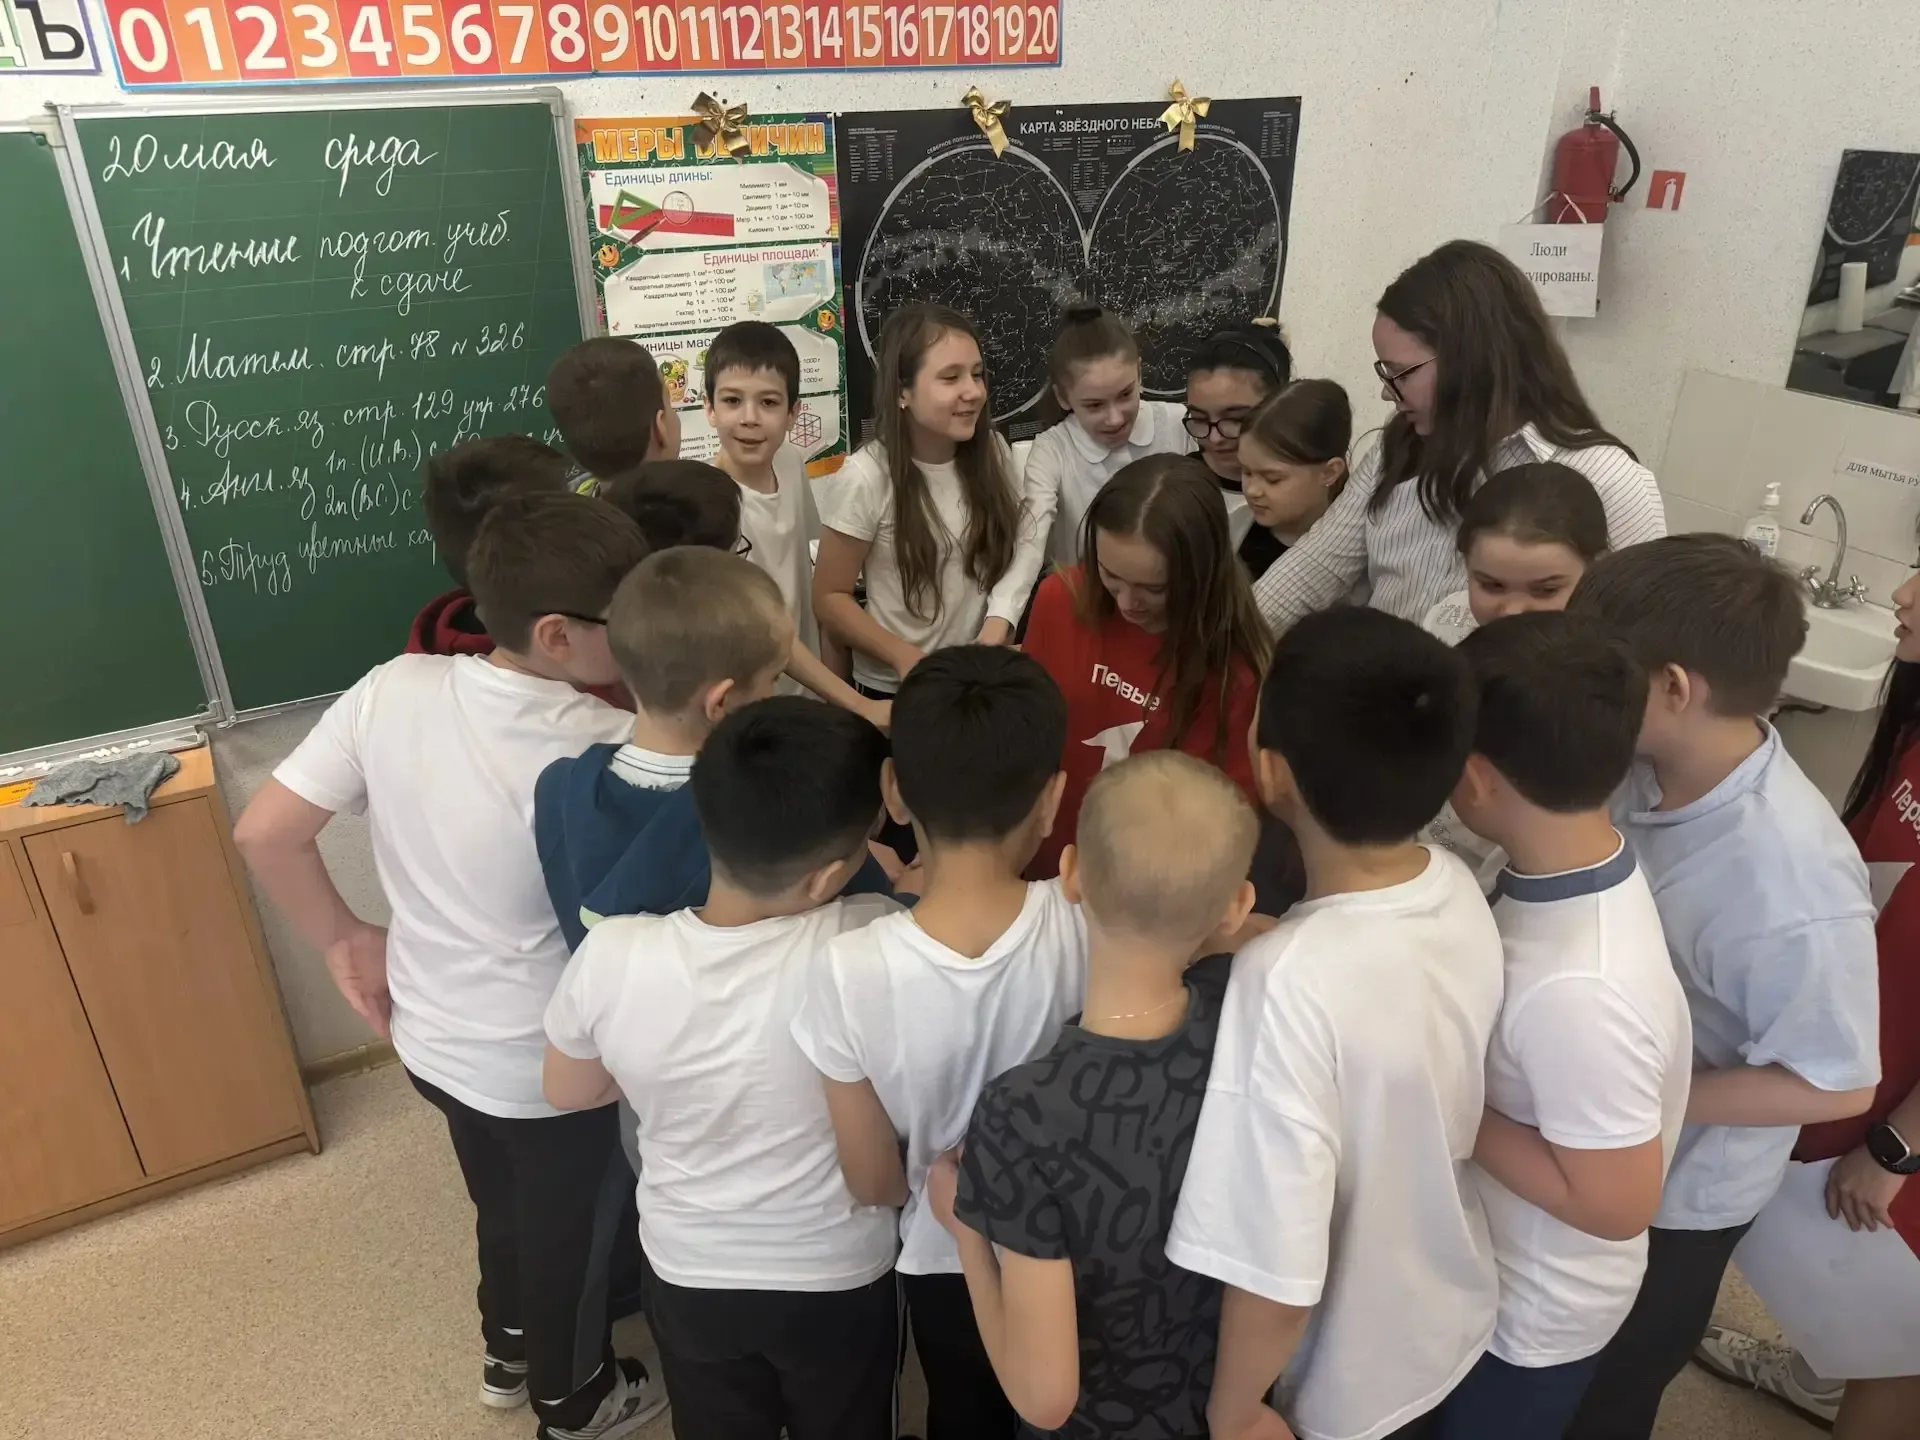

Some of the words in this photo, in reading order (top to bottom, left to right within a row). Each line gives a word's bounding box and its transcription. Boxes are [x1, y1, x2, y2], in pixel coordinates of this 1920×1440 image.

[119, 7, 169, 73] 0
[184, 7, 223, 71] 1
[234, 5, 287, 70] 2
[292, 4, 338, 68] 3
[349, 6, 392, 66] 4
[402, 5, 441, 65] 5
[451, 3, 492, 64] 6
[499, 5, 534, 64] 7
[548, 3, 586, 63] 8
[593, 4, 629, 62] 9
[634, 4, 676, 62] 10
[681, 5, 721, 62] 11
[722, 5, 764, 60] 12
[765, 5, 803, 59] 13
[805, 5, 843, 58] 14
[846, 5, 882, 58] 15
[884, 5, 919, 58] 16
[921, 5, 955, 57] 17
[957, 4, 991, 56] 18
[992, 4, 1025, 56] 19
[1027, 4, 1058, 55] 20
[1020, 121, 1056, 135] КАРТА
[1060, 118, 1128, 133] ЗВЁЗДНОГО
[1132, 118, 1161, 130] НЕБА
[593, 127, 684, 163] МЕРЫ
[696, 122, 825, 159] ИЧИН
[103, 134, 158, 182] 20
[164, 137, 277, 170] мая
[325, 132, 438, 198] среда
[605, 173, 665, 187] Единицы
[669, 171, 713, 184] длины:
[132, 211, 301, 280] Чтение
[320, 229, 436, 281] подгот.
[444, 210, 510, 264] учеб.
[703, 252, 759, 266] Единицы
[762, 248, 819, 261] площади:
[1530, 242, 1567, 256] Люди
[1526, 271, 1594, 286] уированы.
[381, 268, 472, 316] сдаче
[644, 292, 677, 300] Квадратный
[336, 337, 403, 382] стр.
[476, 321, 524, 356] 326
[642, 341, 683, 352] иницы
[687, 338, 715, 349] мас
[344, 400, 404, 441] стр.
[412, 389, 454, 420] 129
[503, 384, 545, 412] 276
[1845, 462, 1868, 474] ДЛЯ
[1869, 467, 1906, 484] МЫТЬЯ
[1907, 476, 1920, 487] РУ
